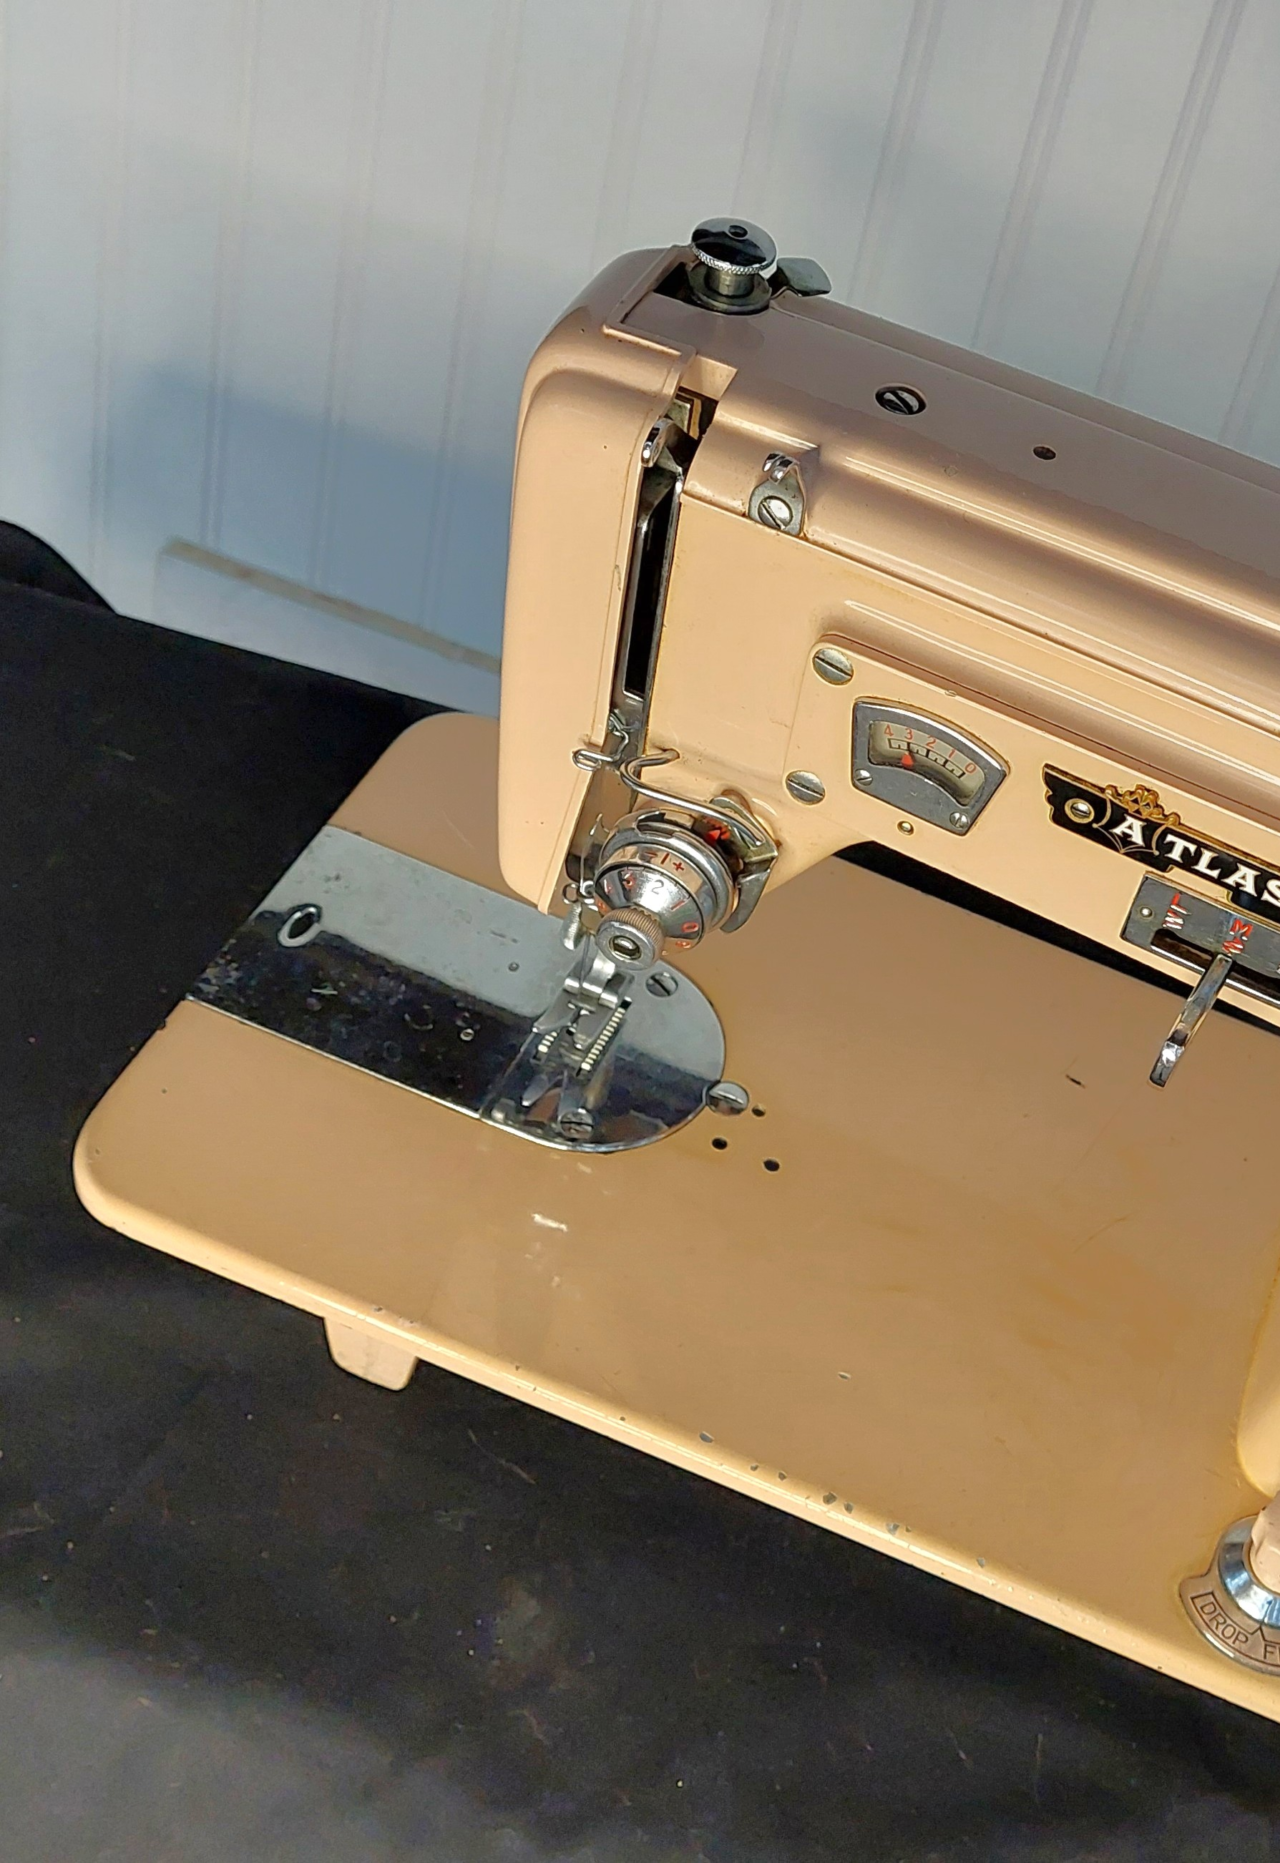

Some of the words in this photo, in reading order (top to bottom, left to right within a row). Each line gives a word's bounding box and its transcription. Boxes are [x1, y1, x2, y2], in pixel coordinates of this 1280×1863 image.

[884, 724, 894, 737] 4
[905, 727, 914, 741] 3
[926, 735, 937, 749] 2
[948, 747, 956, 759] 1
[965, 762, 977, 774] 0
[651, 879, 665, 895] 2
[1201, 1601, 1249, 1645] DROP
